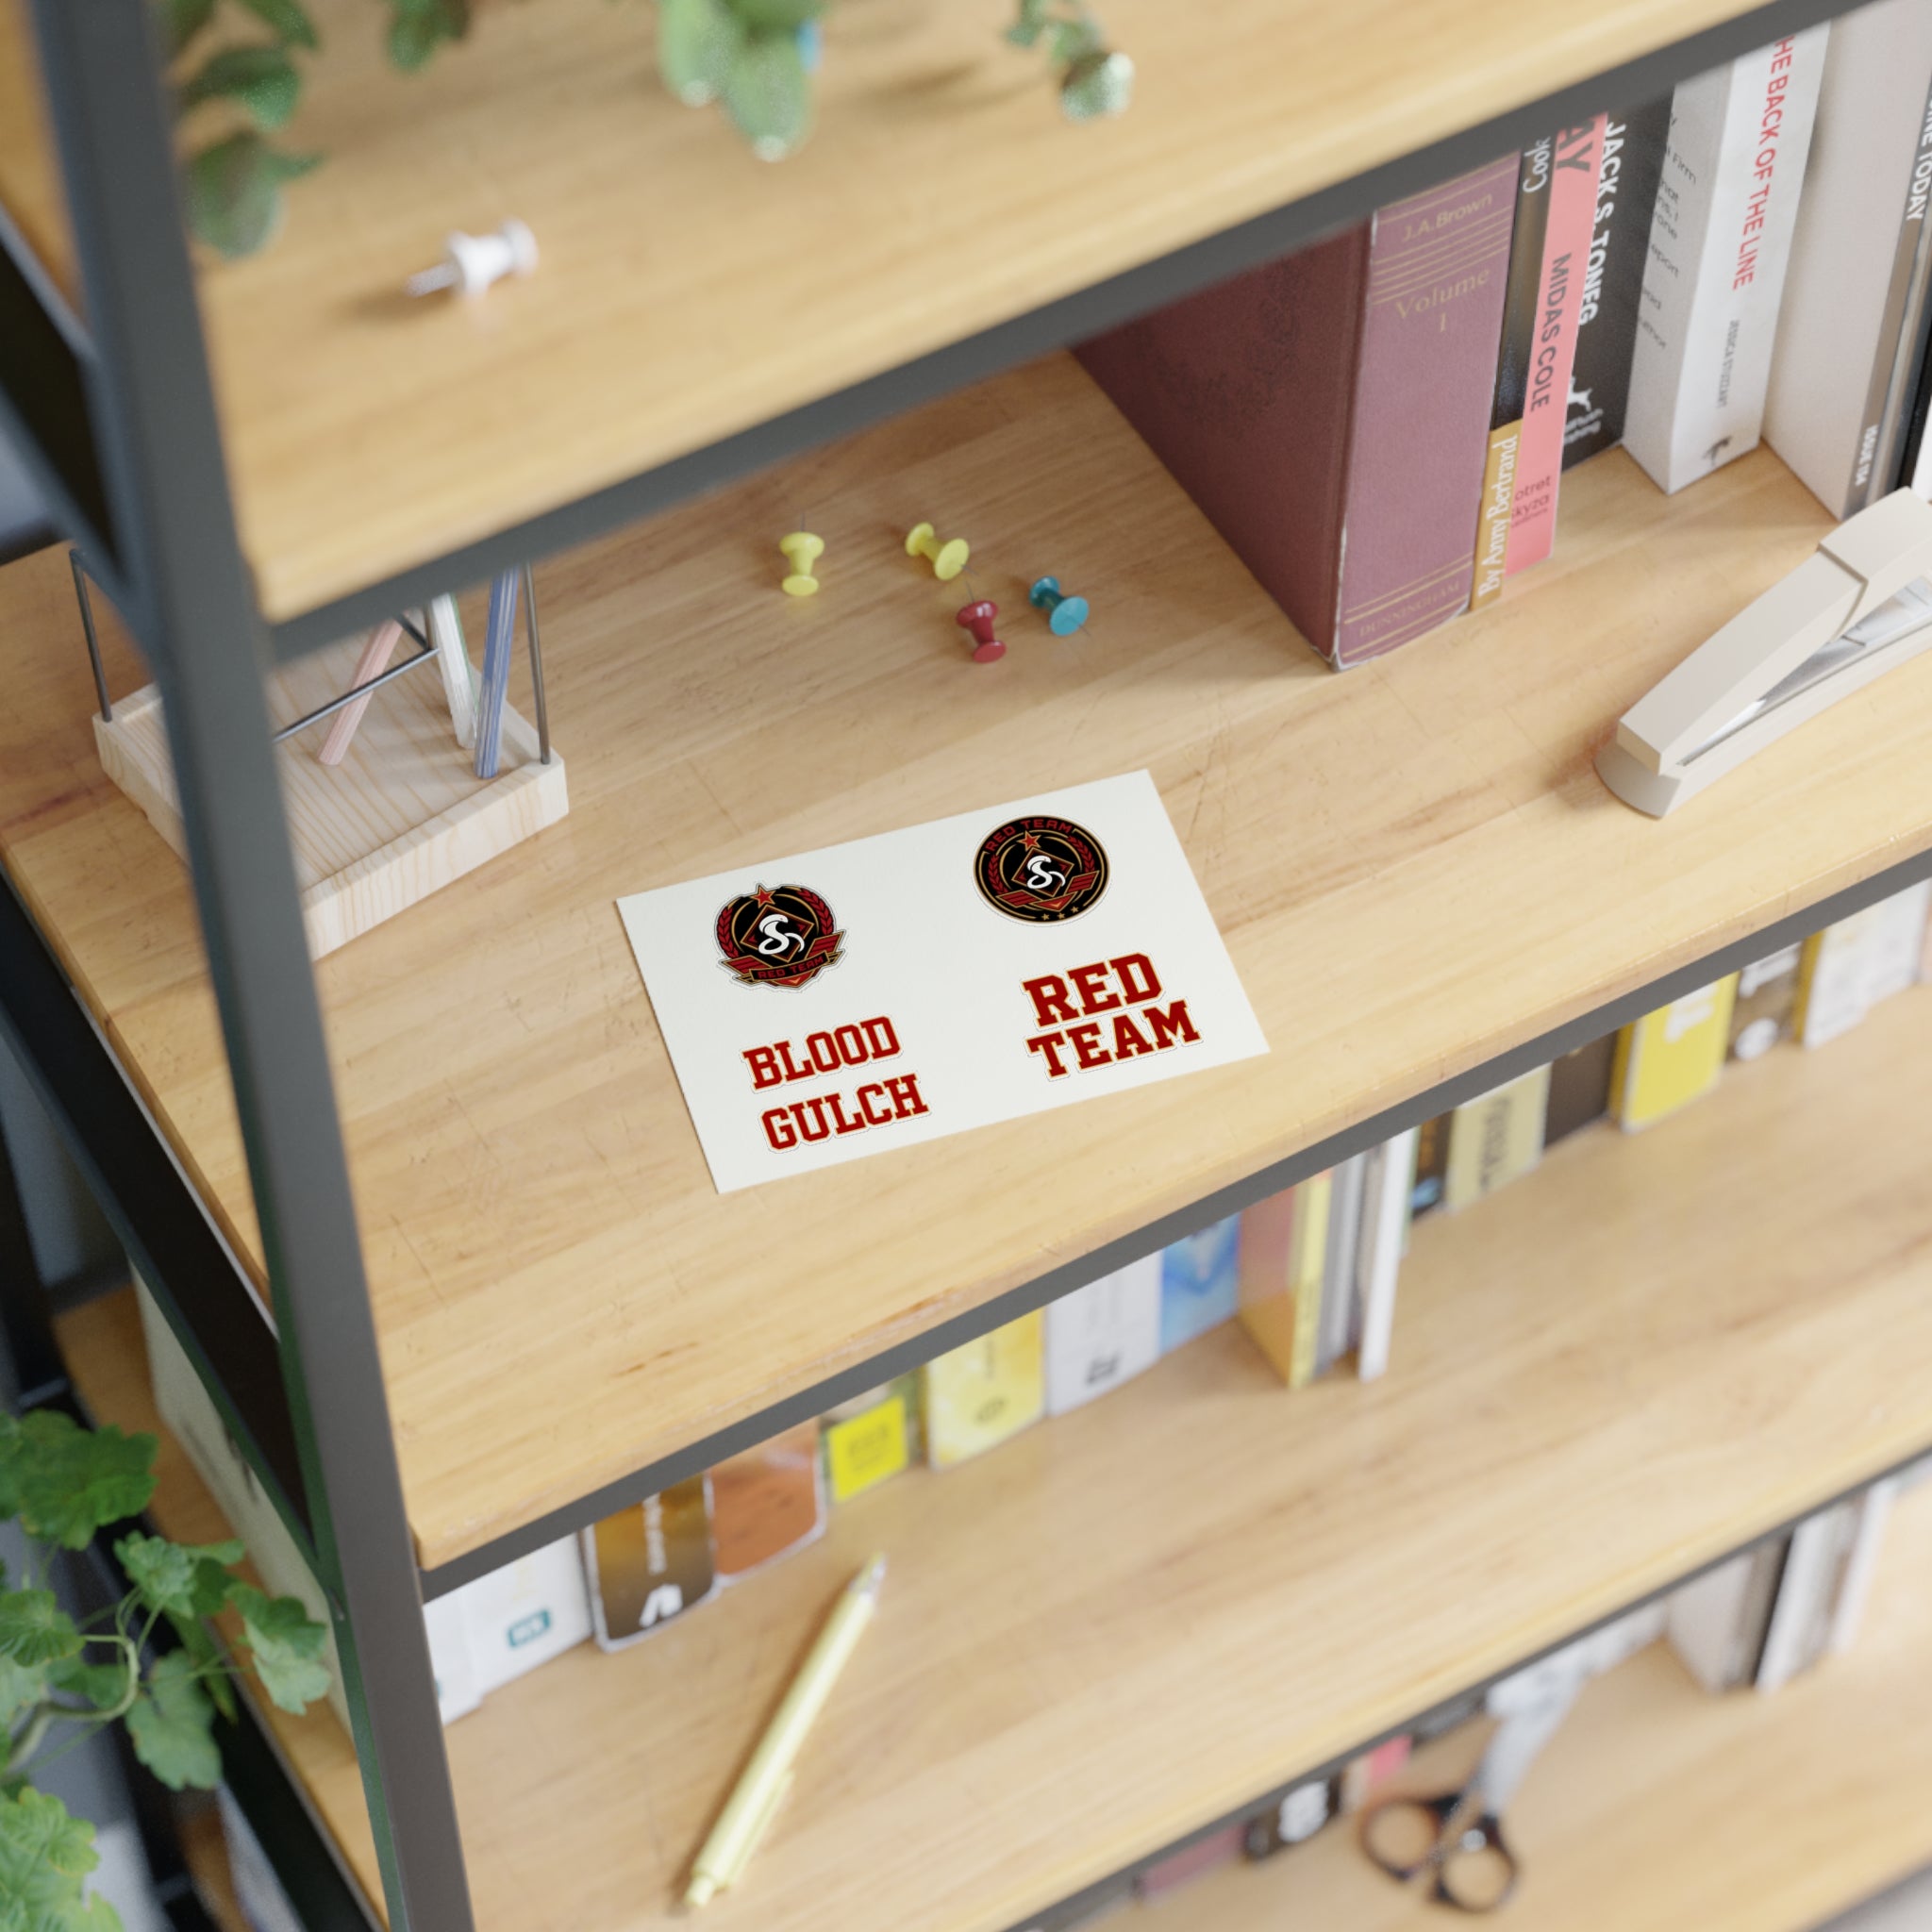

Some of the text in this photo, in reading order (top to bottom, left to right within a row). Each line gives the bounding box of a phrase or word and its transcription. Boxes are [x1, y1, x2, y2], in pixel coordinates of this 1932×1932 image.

[1759, 74, 1789, 145] BACK
[1523, 136, 1551, 193] Cook
[1597, 122, 1626, 201] JACK
[1753, 147, 1776, 181] OF
[1906, 151, 1932, 221] TODAY
[1743, 183, 1771, 236] THE
[1396, 269, 1491, 319] Volume
[1733, 235, 1761, 291] LINE
[1529, 252, 1573, 412] MIDAS COLE
[1486, 433, 1519, 521] Bertrand
[1477, 567, 1506, 598] By
[985, 819, 1073, 851] RED TEAM
[757, 956, 824, 979] RED TEAM
[1024, 953, 1161, 1025] RED
[743, 1017, 900, 1089] BLOOD
[1028, 1001, 1200, 1077] TEAM
[762, 1074, 926, 1150] GULCH
